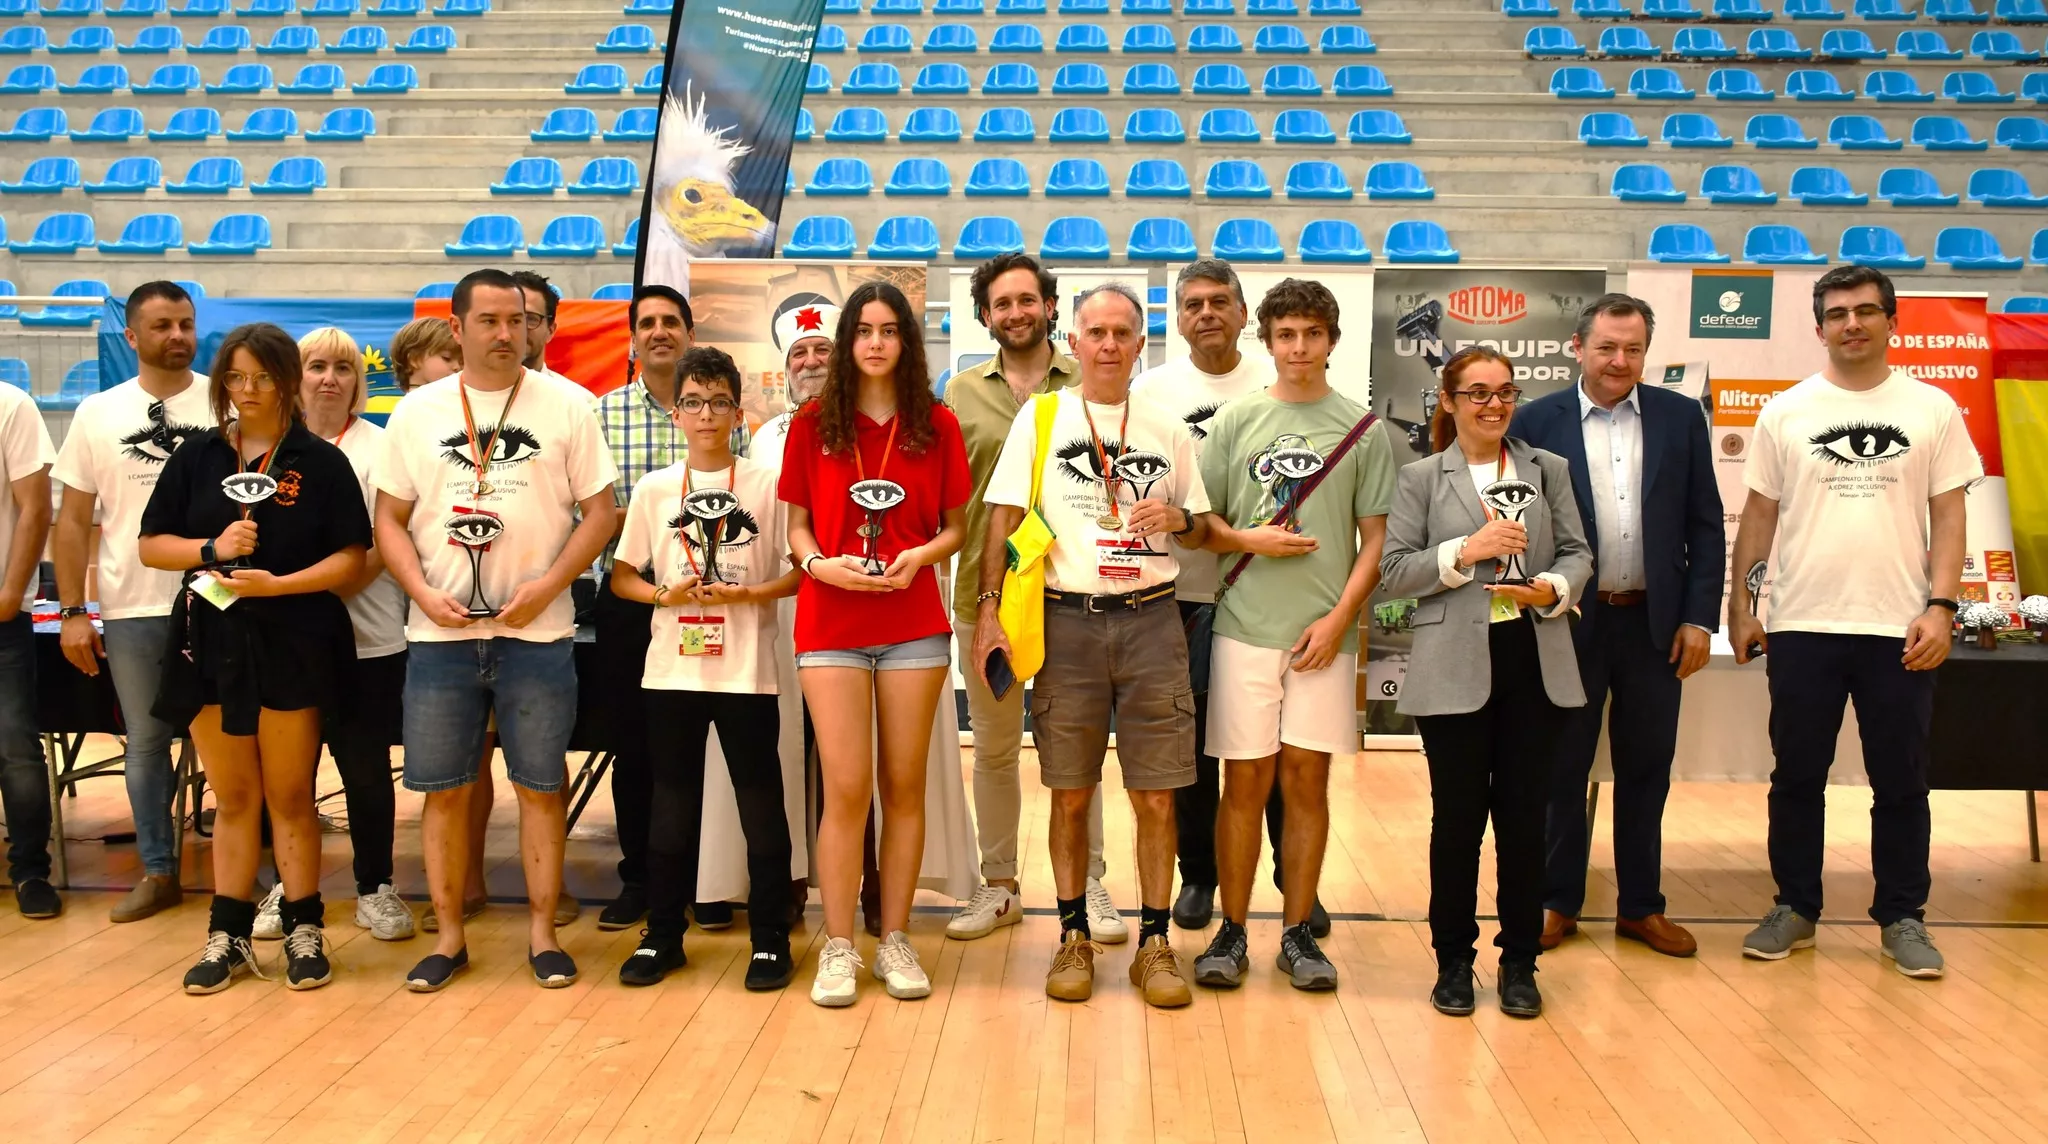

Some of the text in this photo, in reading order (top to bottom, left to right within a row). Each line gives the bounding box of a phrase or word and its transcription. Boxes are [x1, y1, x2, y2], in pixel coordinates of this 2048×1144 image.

[1448, 286, 1526, 318] TATOMA
[1699, 314, 1762, 325] defeder
[1904, 335, 1924, 349] DE
[1926, 333, 1990, 350] ESPAÑA
[1394, 339, 1443, 357] UN
[1820, 475, 1861, 483] CAMPEONATO
[726, 563, 749, 571] ESPAÑA
[633, 948, 657, 957] PUMA
